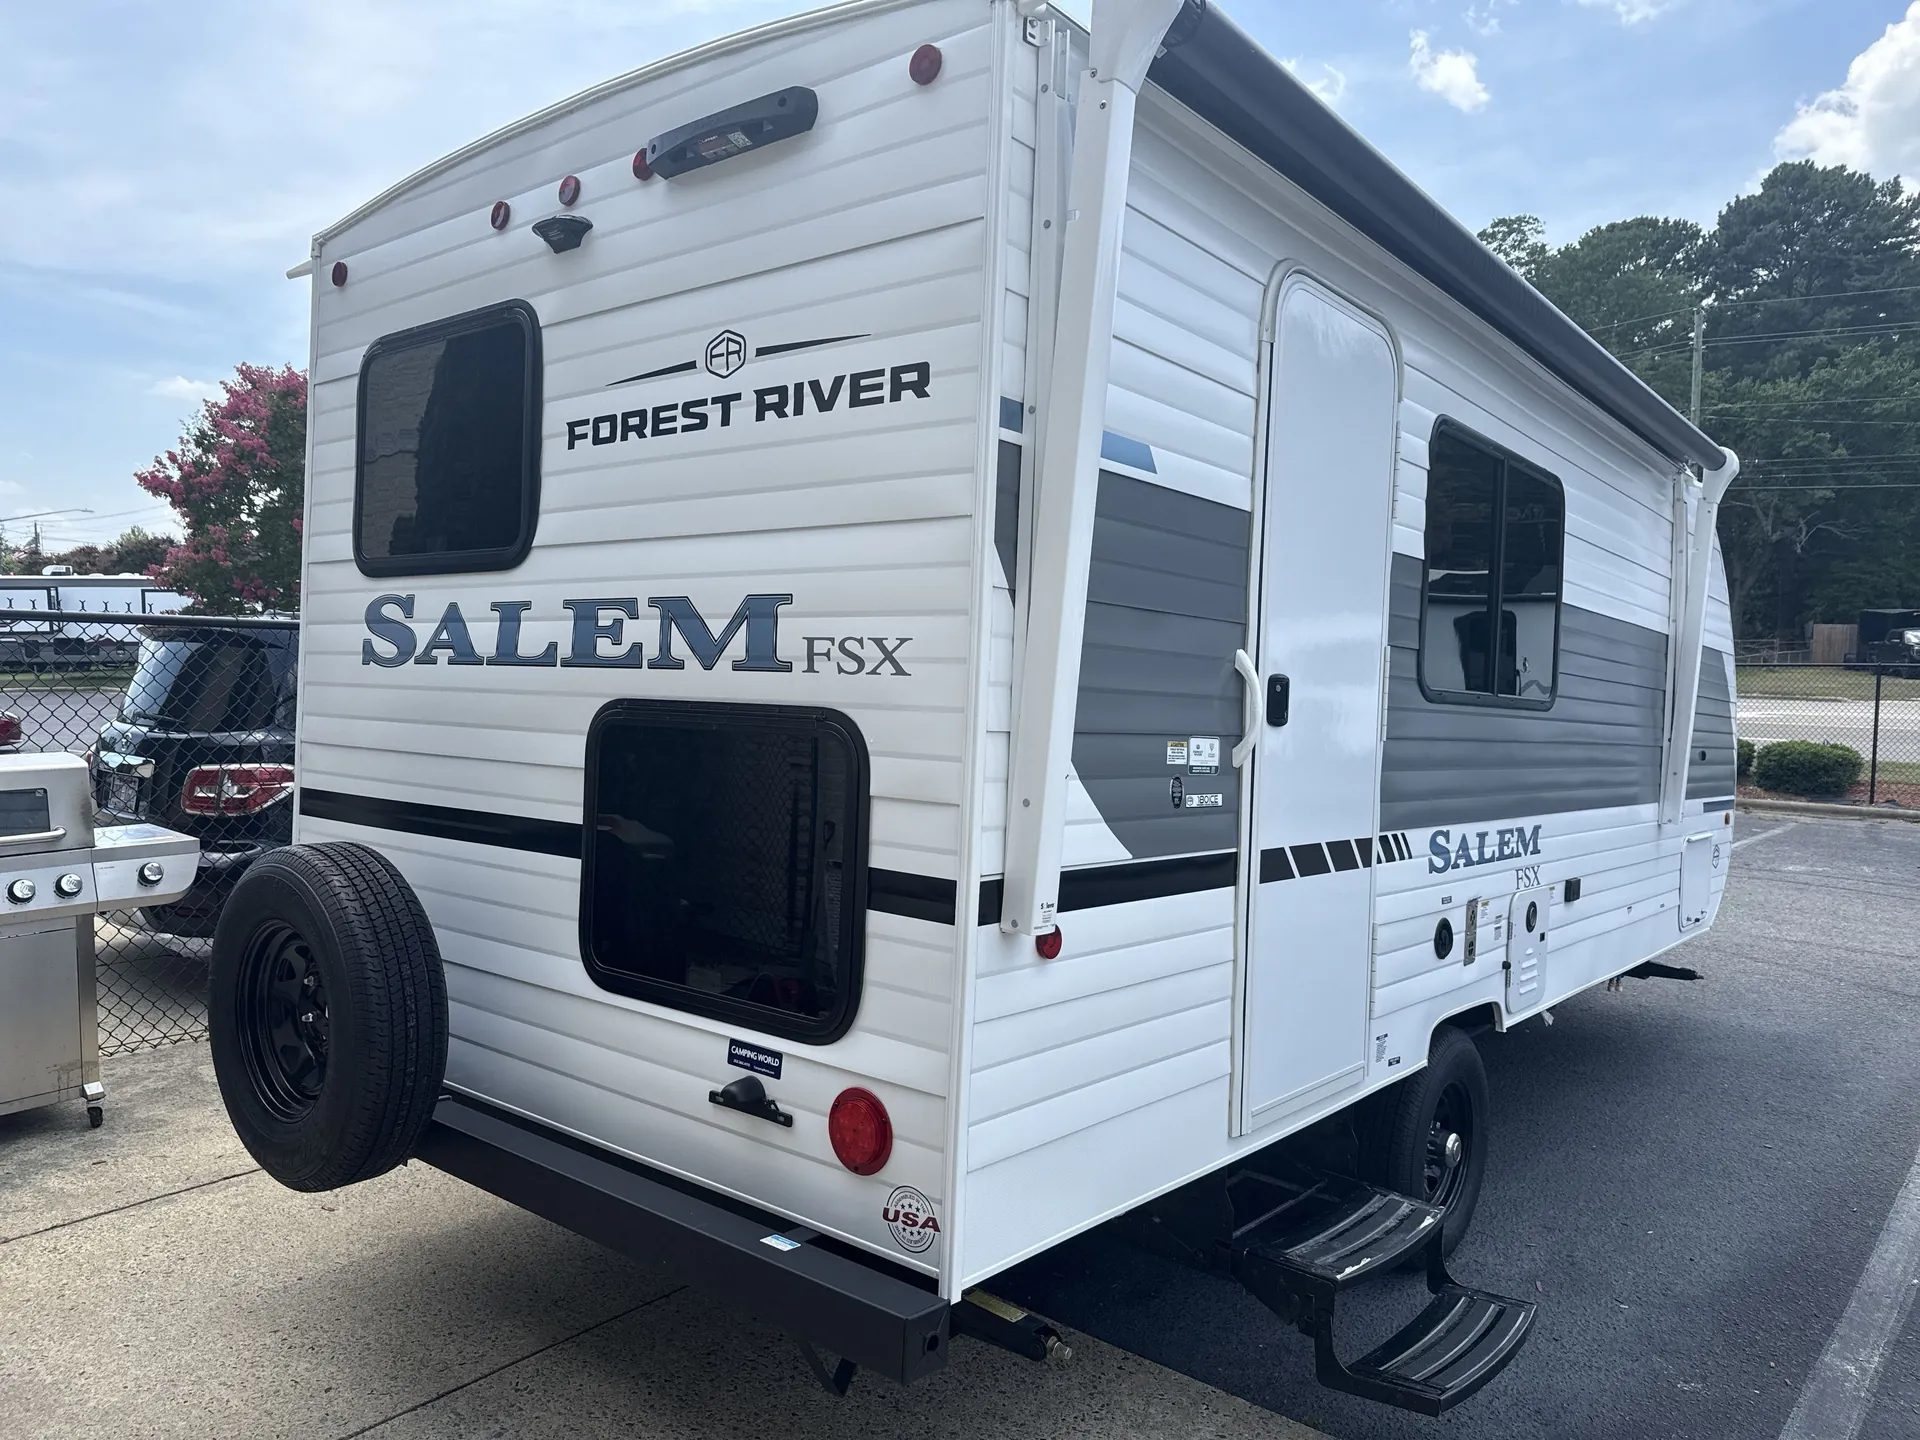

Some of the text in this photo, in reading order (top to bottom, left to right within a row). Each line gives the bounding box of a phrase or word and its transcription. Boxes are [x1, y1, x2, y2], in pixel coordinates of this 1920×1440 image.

[566, 361, 931, 451] FOREST RIVER
[362, 593, 914, 677] SALEM FSX
[1428, 824, 1542, 875] SALEM
[1515, 865, 1541, 891] FSX
[730, 1045, 758, 1060] CAMPING
[757, 1051, 780, 1067] WORLD
[882, 1207, 941, 1233] USA
